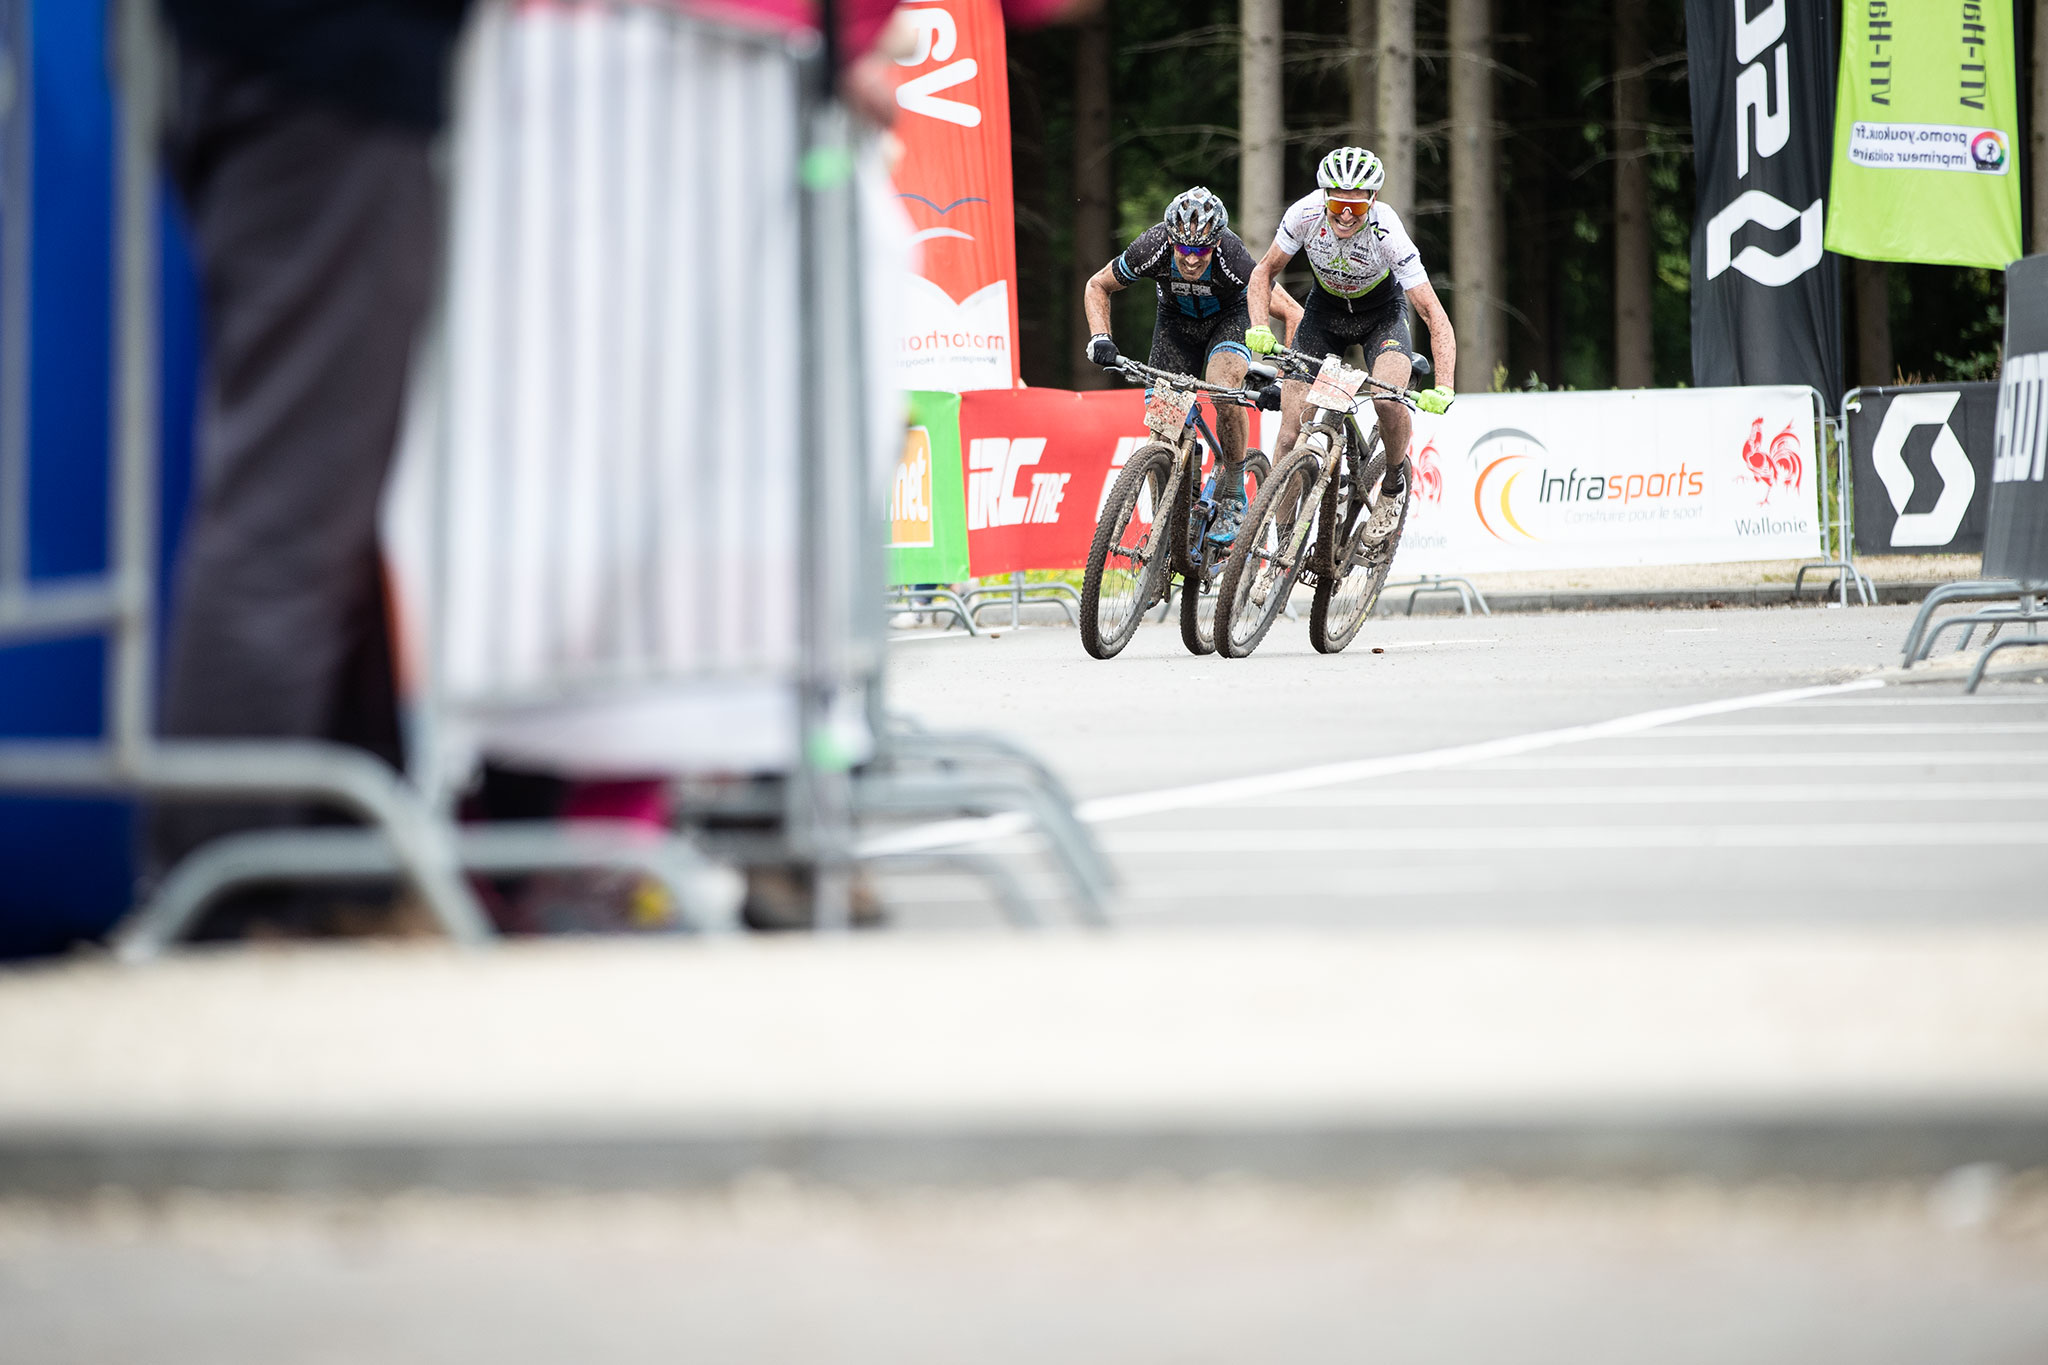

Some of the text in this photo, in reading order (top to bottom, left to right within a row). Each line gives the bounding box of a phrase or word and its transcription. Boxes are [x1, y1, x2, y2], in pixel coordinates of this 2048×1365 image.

[1140, 241, 1169, 271] GIANT
[1219, 257, 1245, 286] GIANT
[1024, 472, 1072, 524] TIRE
[1538, 462, 1704, 505] Infrasports
[1628, 509, 1656, 522] pour
[1660, 506, 1670, 520] le
[1673, 504, 1703, 520] sport
[1735, 517, 1808, 536] Wallonie
